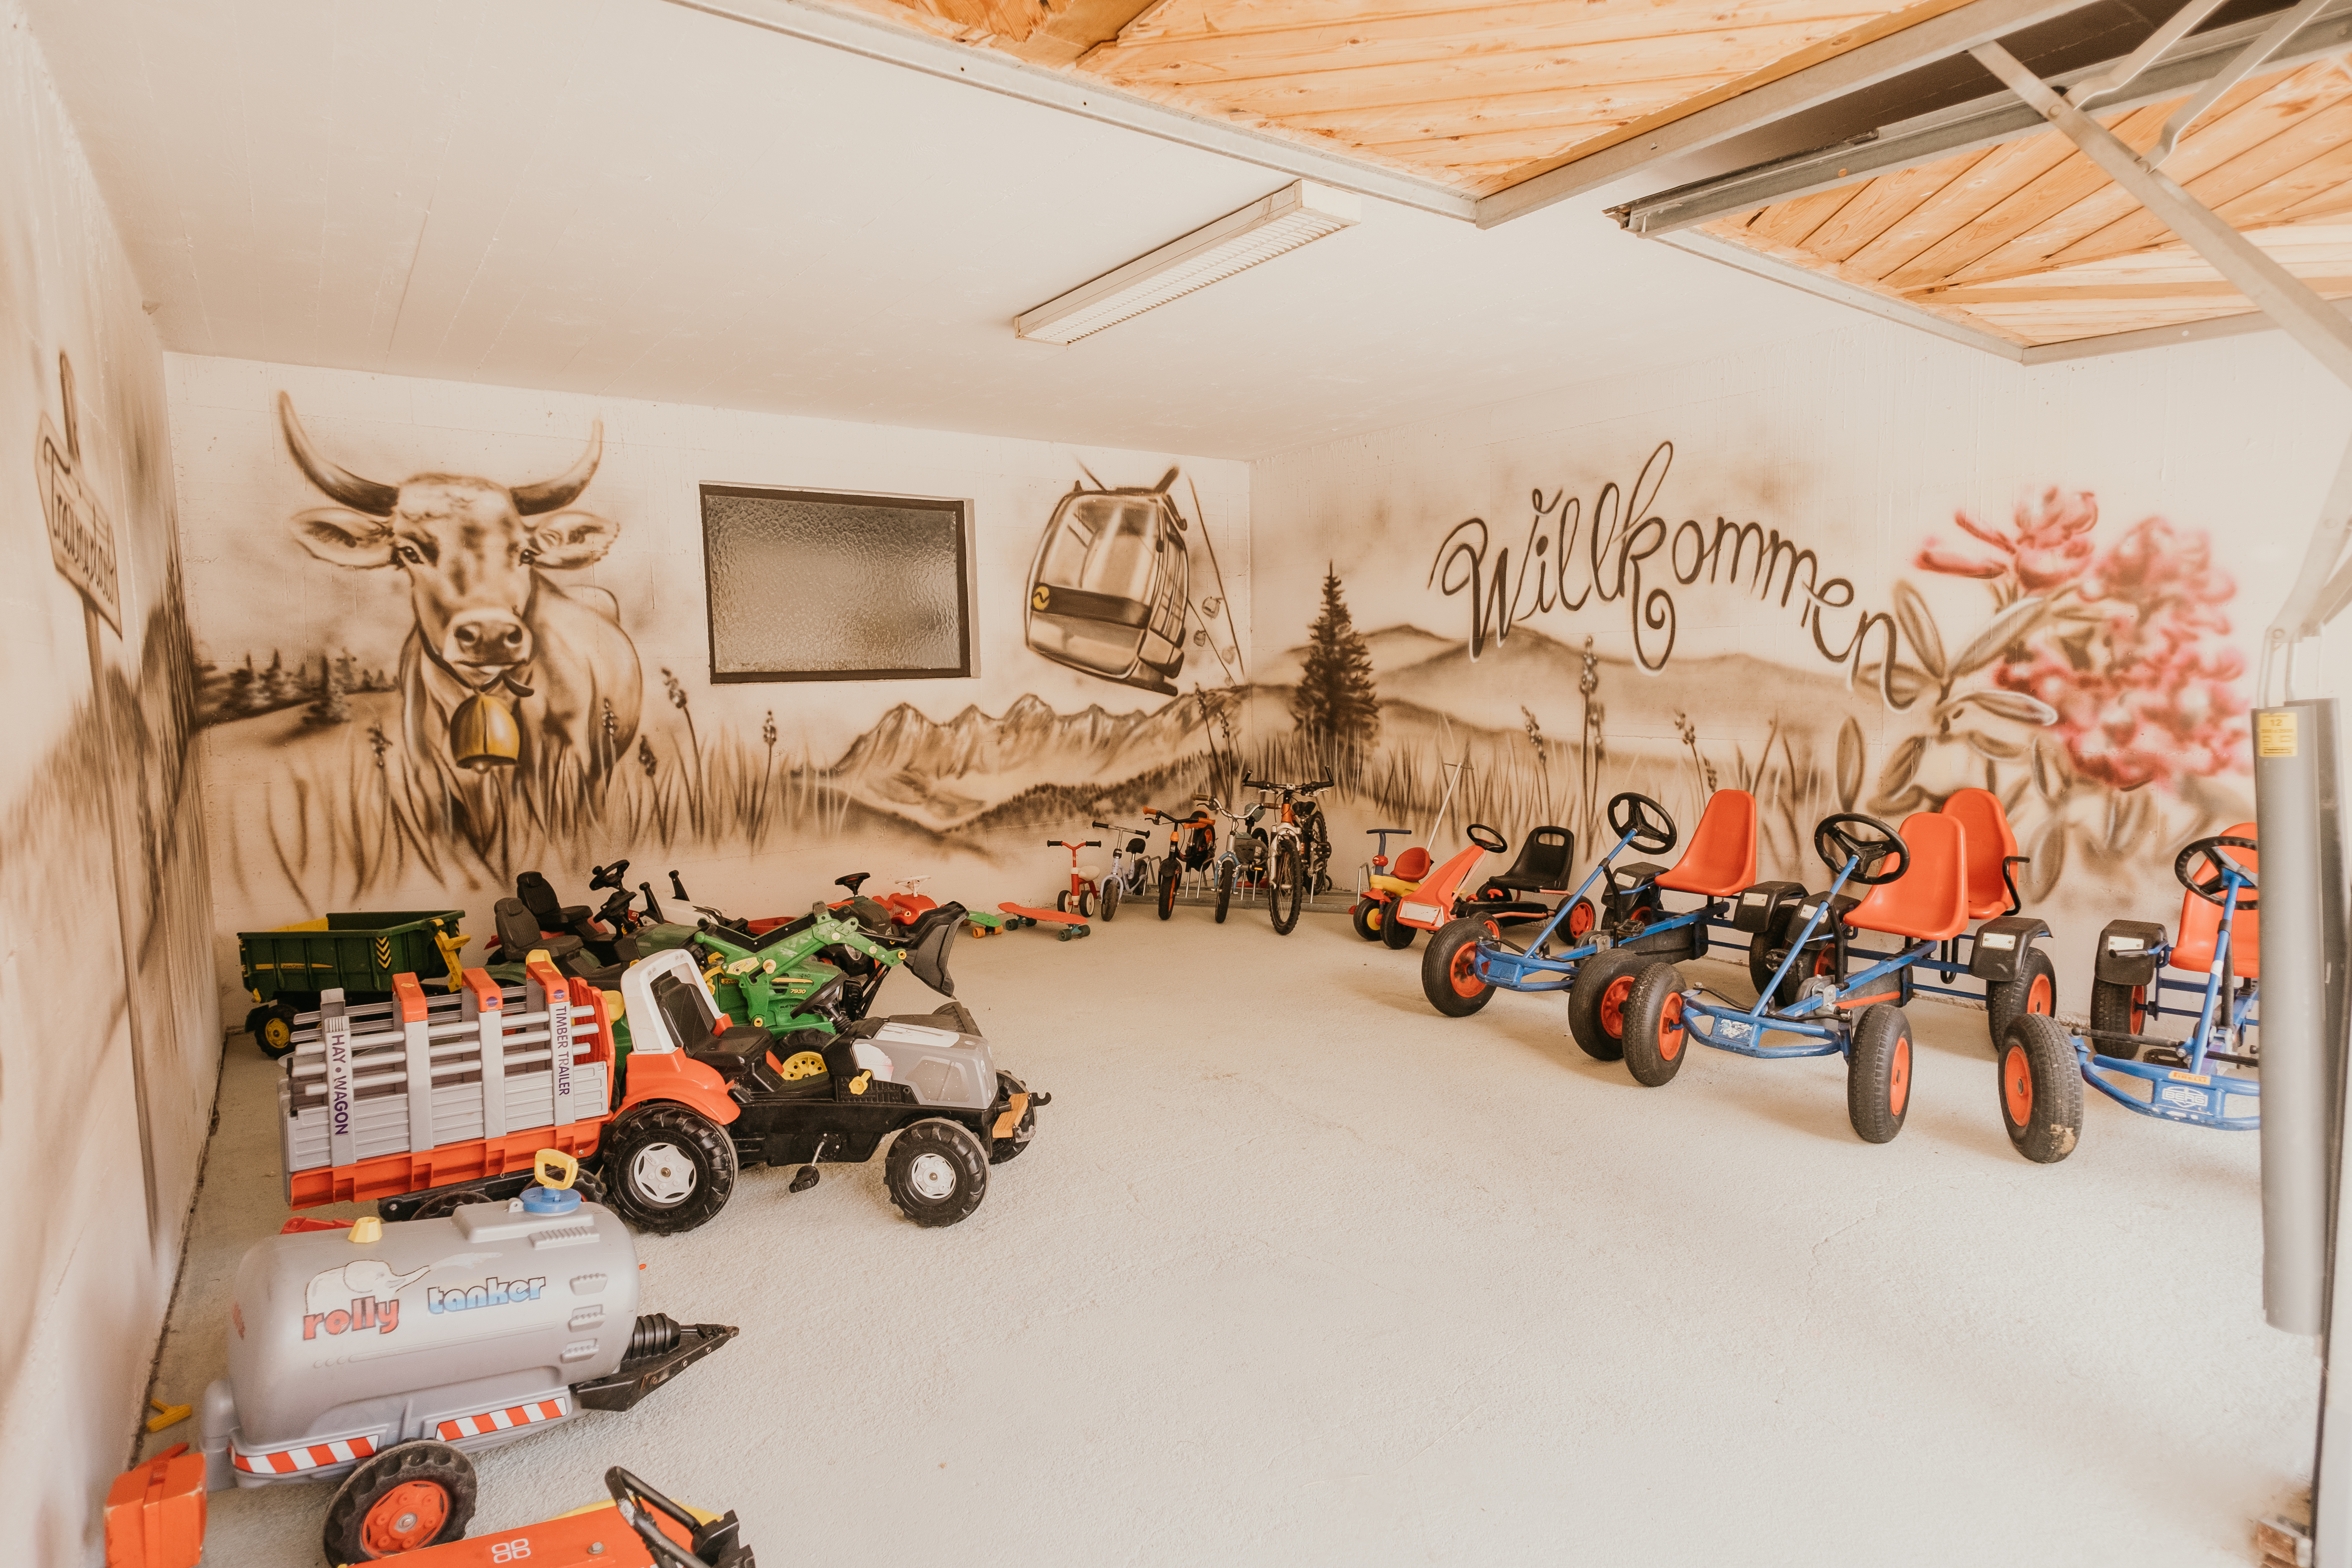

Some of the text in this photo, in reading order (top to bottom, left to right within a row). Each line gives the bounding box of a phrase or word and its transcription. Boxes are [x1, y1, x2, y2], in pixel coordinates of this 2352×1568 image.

[1428, 440, 1918, 711] Willkommen
[331, 1034, 348, 1135] HAY WAGON
[555, 1005, 570, 1096] TIMBER TRAILER
[2173, 1072, 2207, 1082] PIRELLI
[2165, 1090, 2205, 1104] BERG
[303, 1276, 546, 1341] rolly tanker
